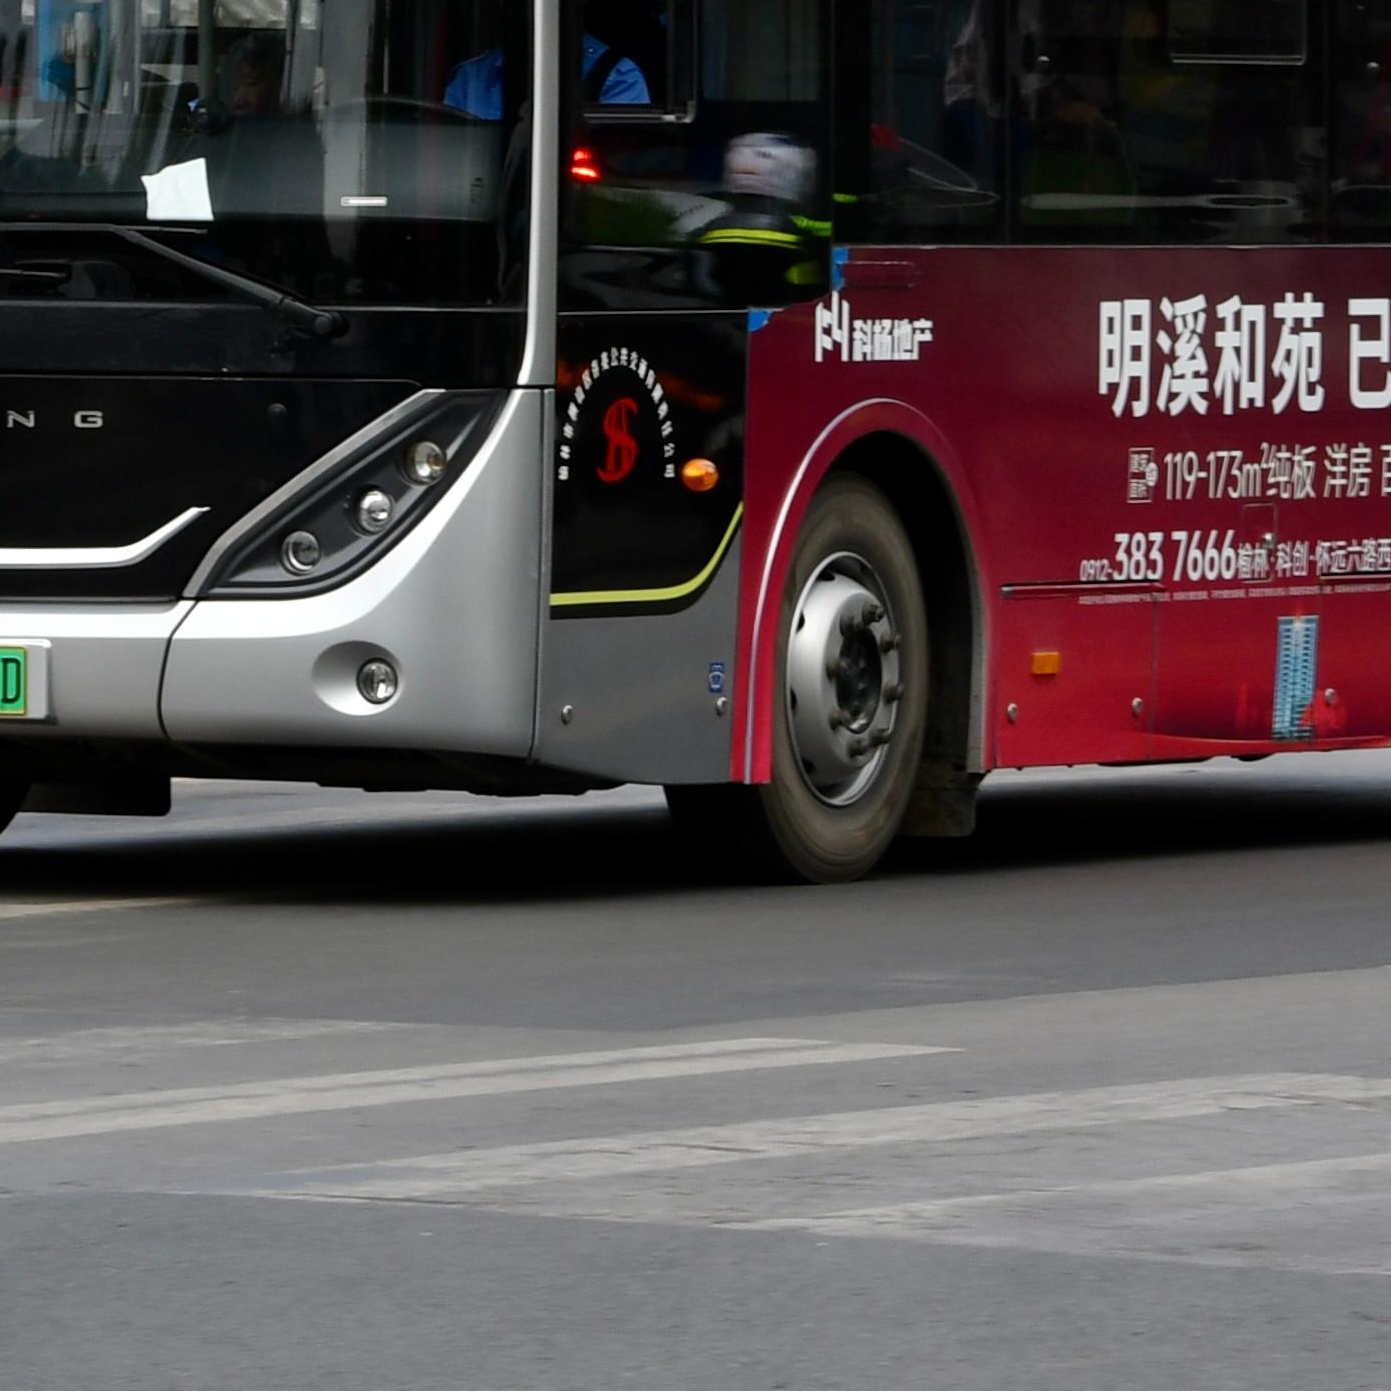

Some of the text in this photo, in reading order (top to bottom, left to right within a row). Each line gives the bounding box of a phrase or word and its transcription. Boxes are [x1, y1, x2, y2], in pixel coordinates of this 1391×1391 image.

[1098, 293, 1326, 417] 明溪和苑
[1323, 443, 1371, 498] 洋房
[1171, 529, 1237, 582] 7666
